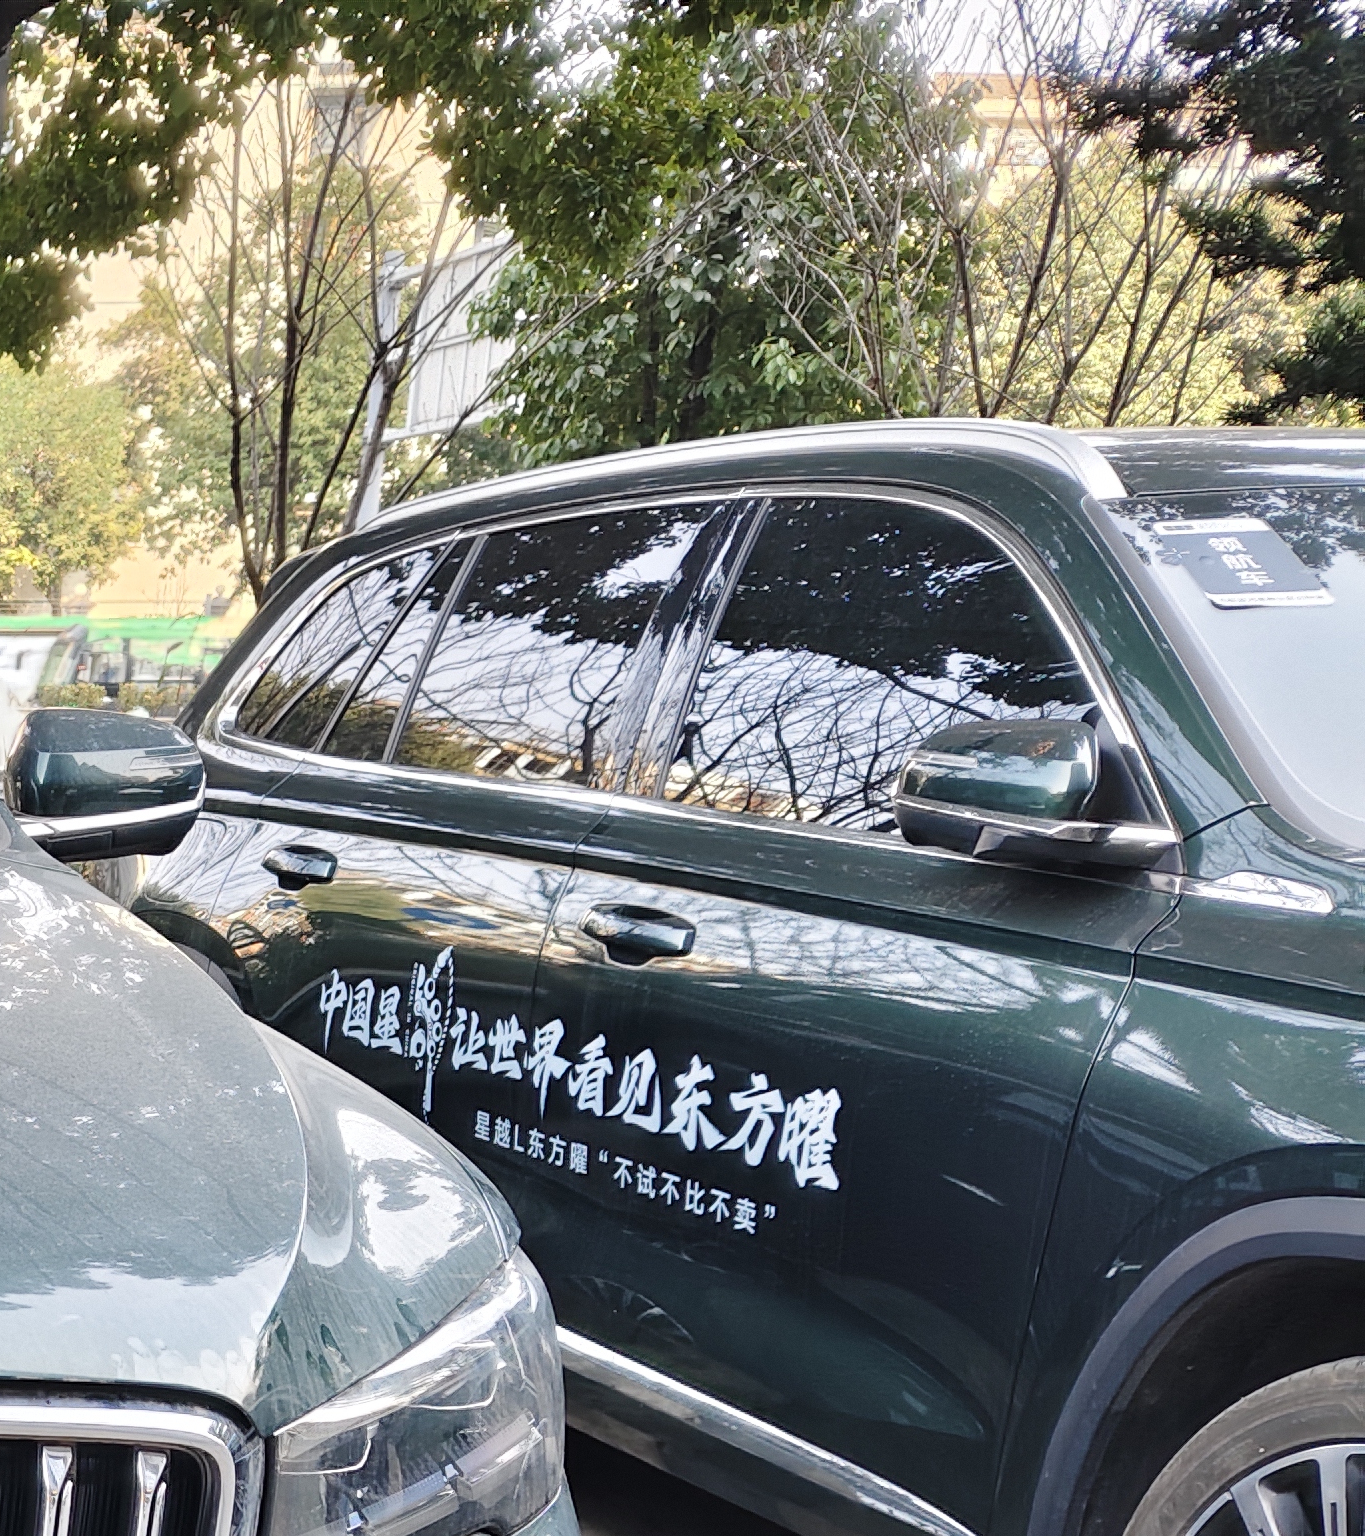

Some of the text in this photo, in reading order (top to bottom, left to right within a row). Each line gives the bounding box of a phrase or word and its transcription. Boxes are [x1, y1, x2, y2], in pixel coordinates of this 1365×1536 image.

[1208, 536, 1275, 586] 领航车
[319, 968, 842, 1191] 中国星 让世界看见东方曜
